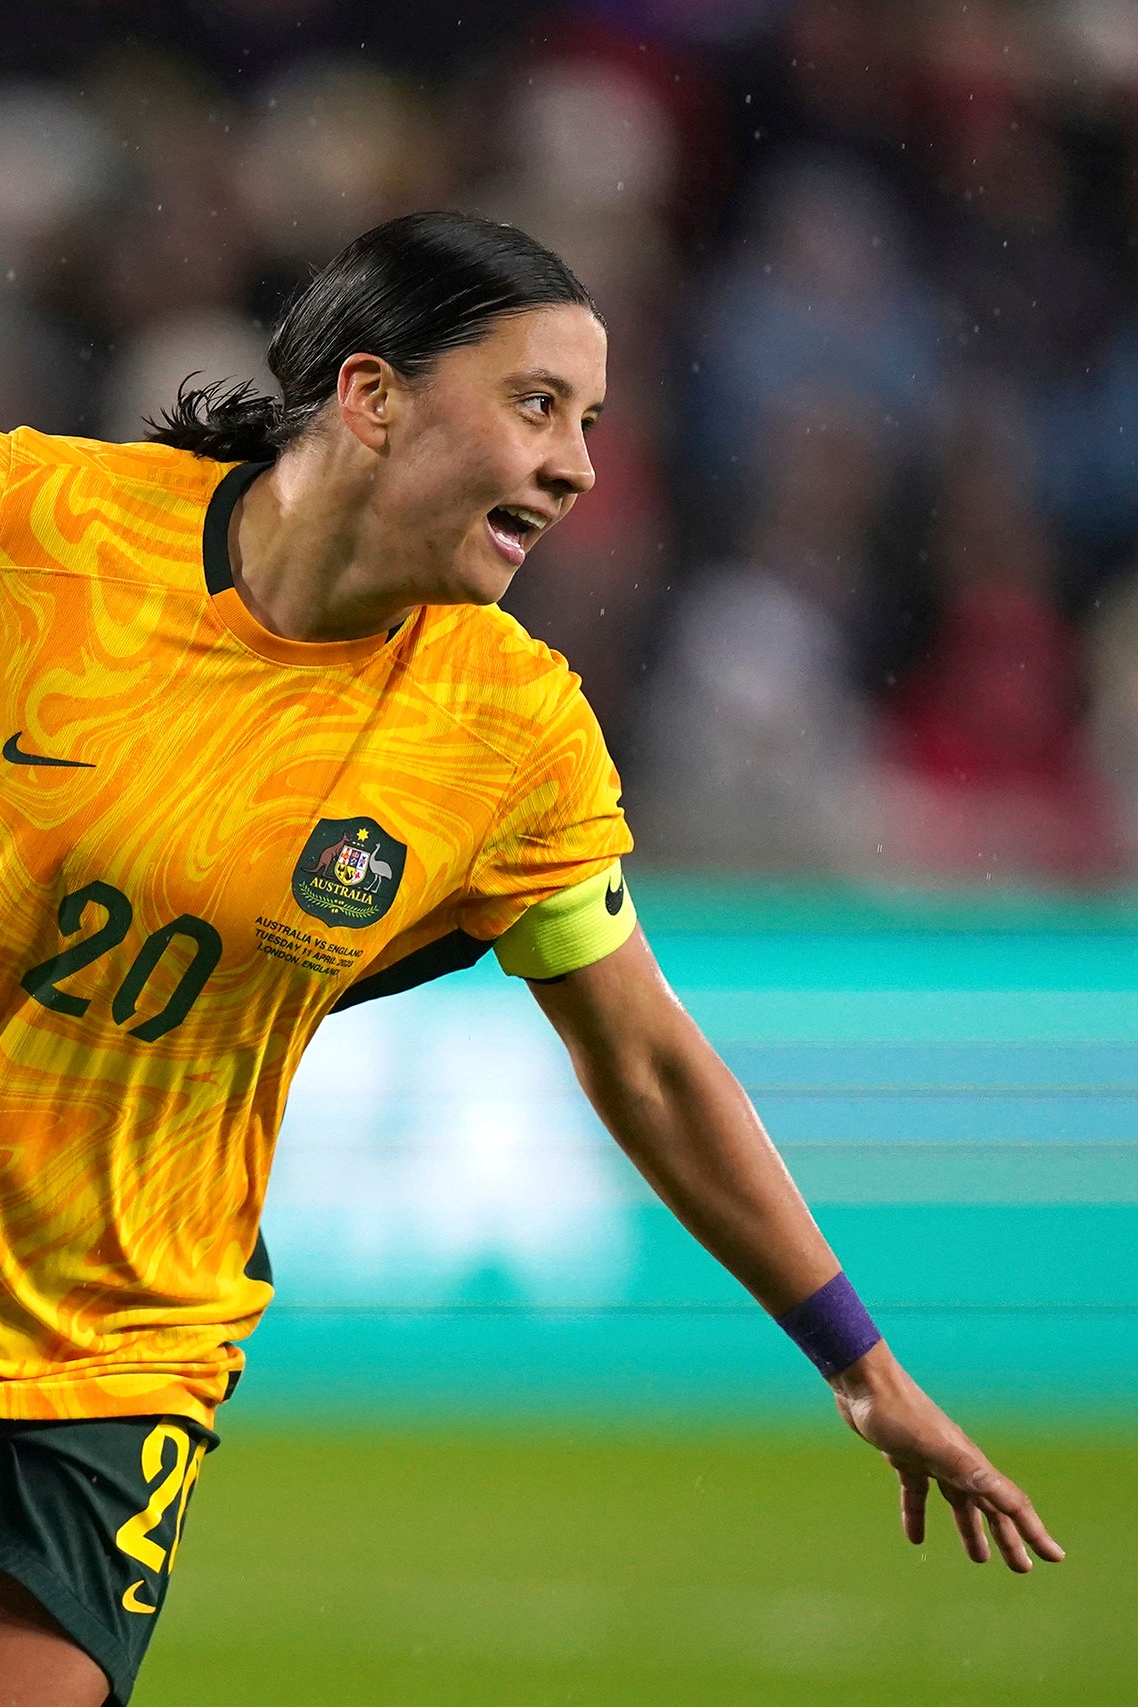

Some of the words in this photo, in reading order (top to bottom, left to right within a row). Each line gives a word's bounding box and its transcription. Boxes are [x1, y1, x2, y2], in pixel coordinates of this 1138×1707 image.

[309, 877, 373, 905] AUSTRALIA
[255, 916, 312, 944] AUSTRALIA
[314, 938, 327, 950] VS
[327, 944, 364, 958] ENGLAND
[255, 928, 302, 951] TUESDAY
[302, 947, 312, 957] 11
[312, 952, 336, 965] APRIL
[20, 880, 223, 1043] 20
[301, 960, 340, 975] ENGLAND
